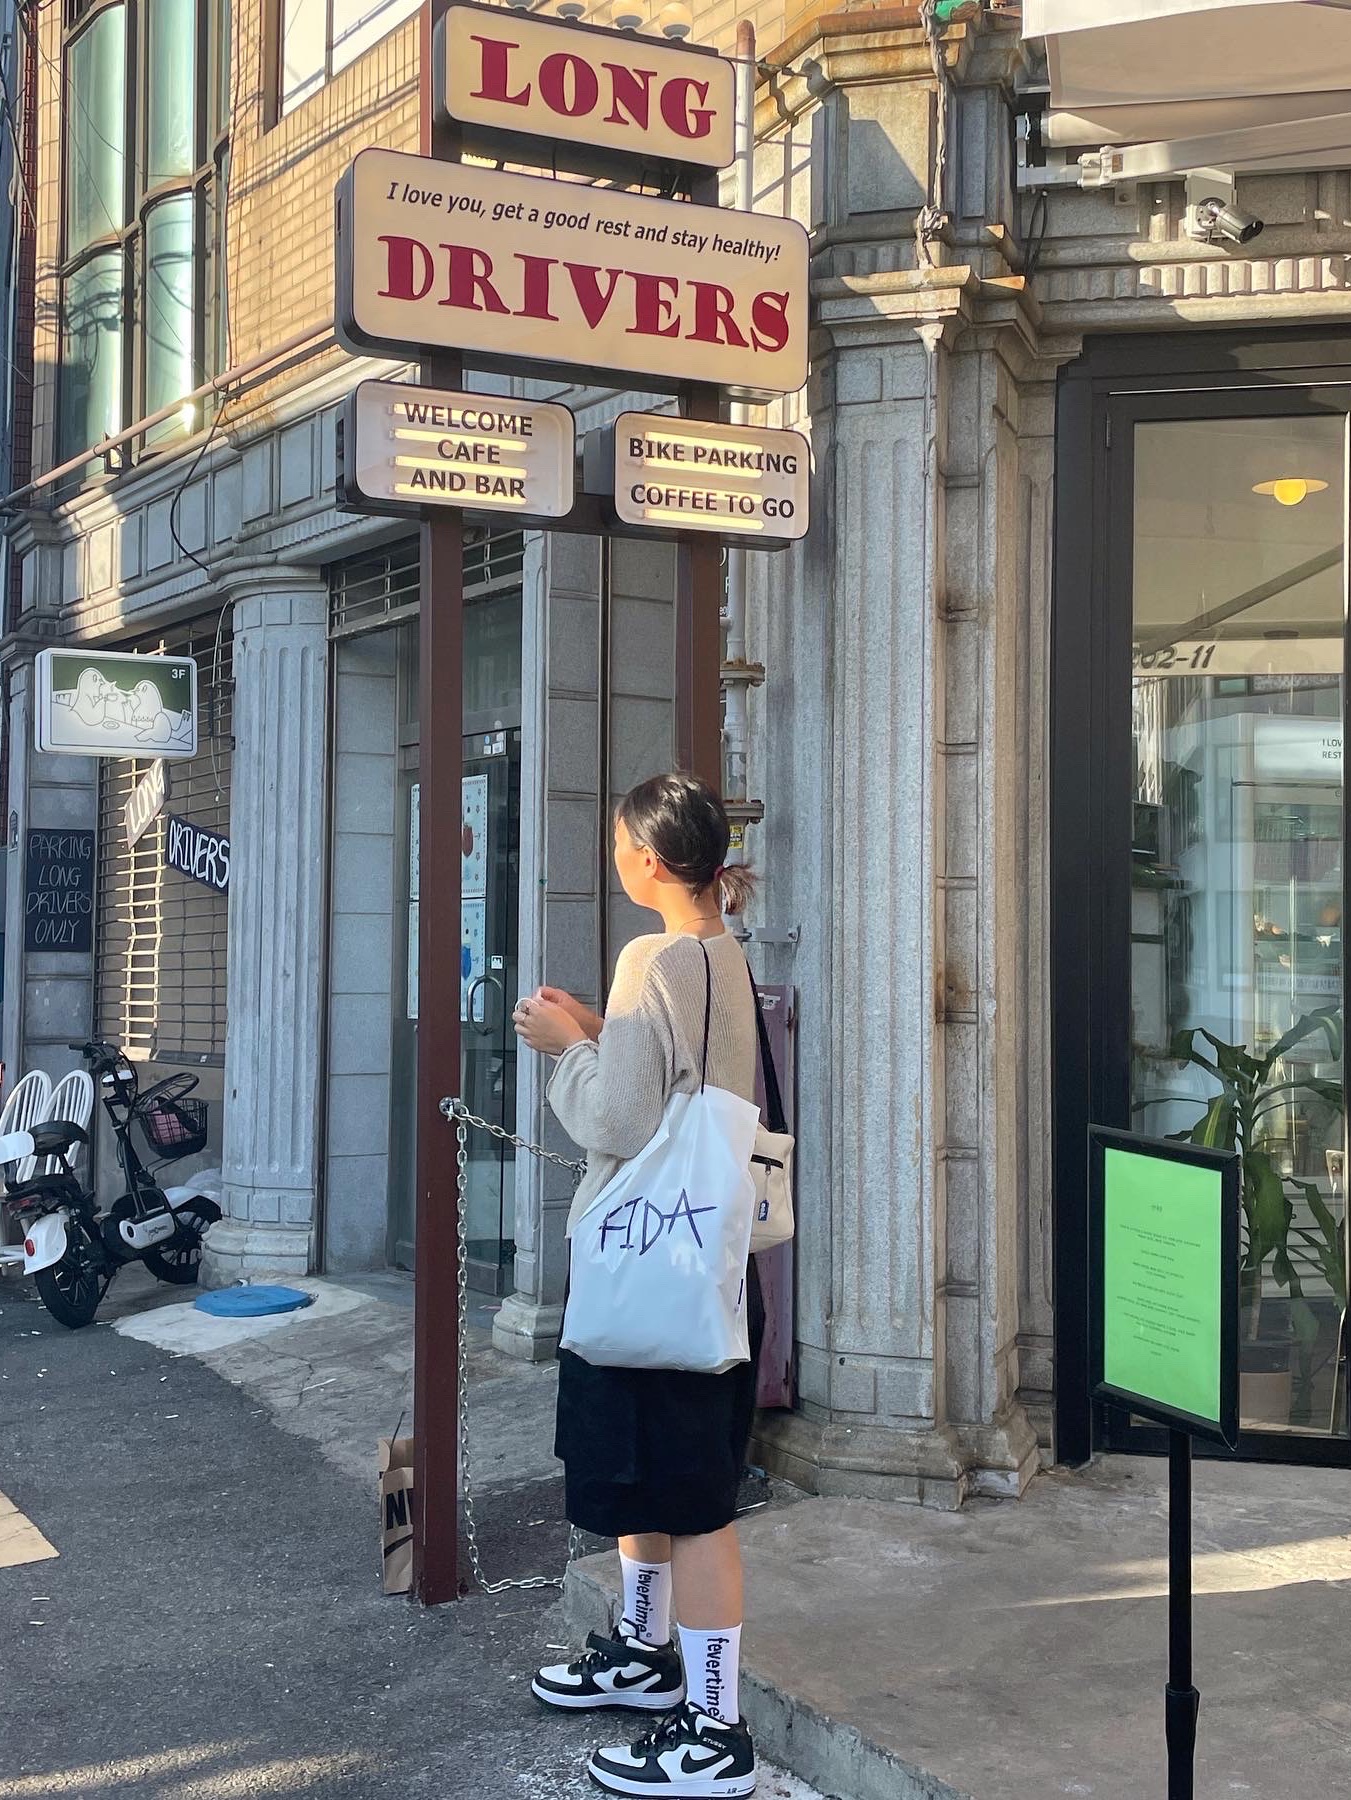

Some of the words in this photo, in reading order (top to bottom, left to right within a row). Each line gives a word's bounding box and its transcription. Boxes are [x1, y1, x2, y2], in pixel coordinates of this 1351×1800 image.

[470, 35, 717, 139] LONG
[386, 182, 399, 200] I
[402, 184, 442, 207] love
[447, 195, 487, 218] you,
[491, 202, 525, 221] get
[528, 208, 539, 222] a
[543, 212, 591, 229] good
[595, 219, 632, 237] rest
[634, 225, 668, 243] and
[671, 229, 708, 253] stay
[712, 233, 781, 264] healthy!
[377, 235, 790, 353] DRIVERS
[404, 402, 533, 436] WELCOME
[437, 439, 500, 464] CAFE
[629, 437, 685, 462] BIKE
[693, 446, 797, 474] PARKING
[410, 468, 466, 491] AND
[475, 474, 526, 498] BAR
[630, 484, 718, 511] COFFEE
[724, 494, 755, 514] TO
[762, 498, 795, 518] GO
[171, 668, 186, 679] 3F
[129, 757, 165, 834] LONG
[30, 834, 92, 859] PARKING
[169, 819, 230, 888] DRIVERS
[38, 864, 81, 887] LONG
[26, 890, 92, 914] DRIVERS
[35, 919, 80, 944] ONLY
[598, 1188, 717, 1256] FIDA
